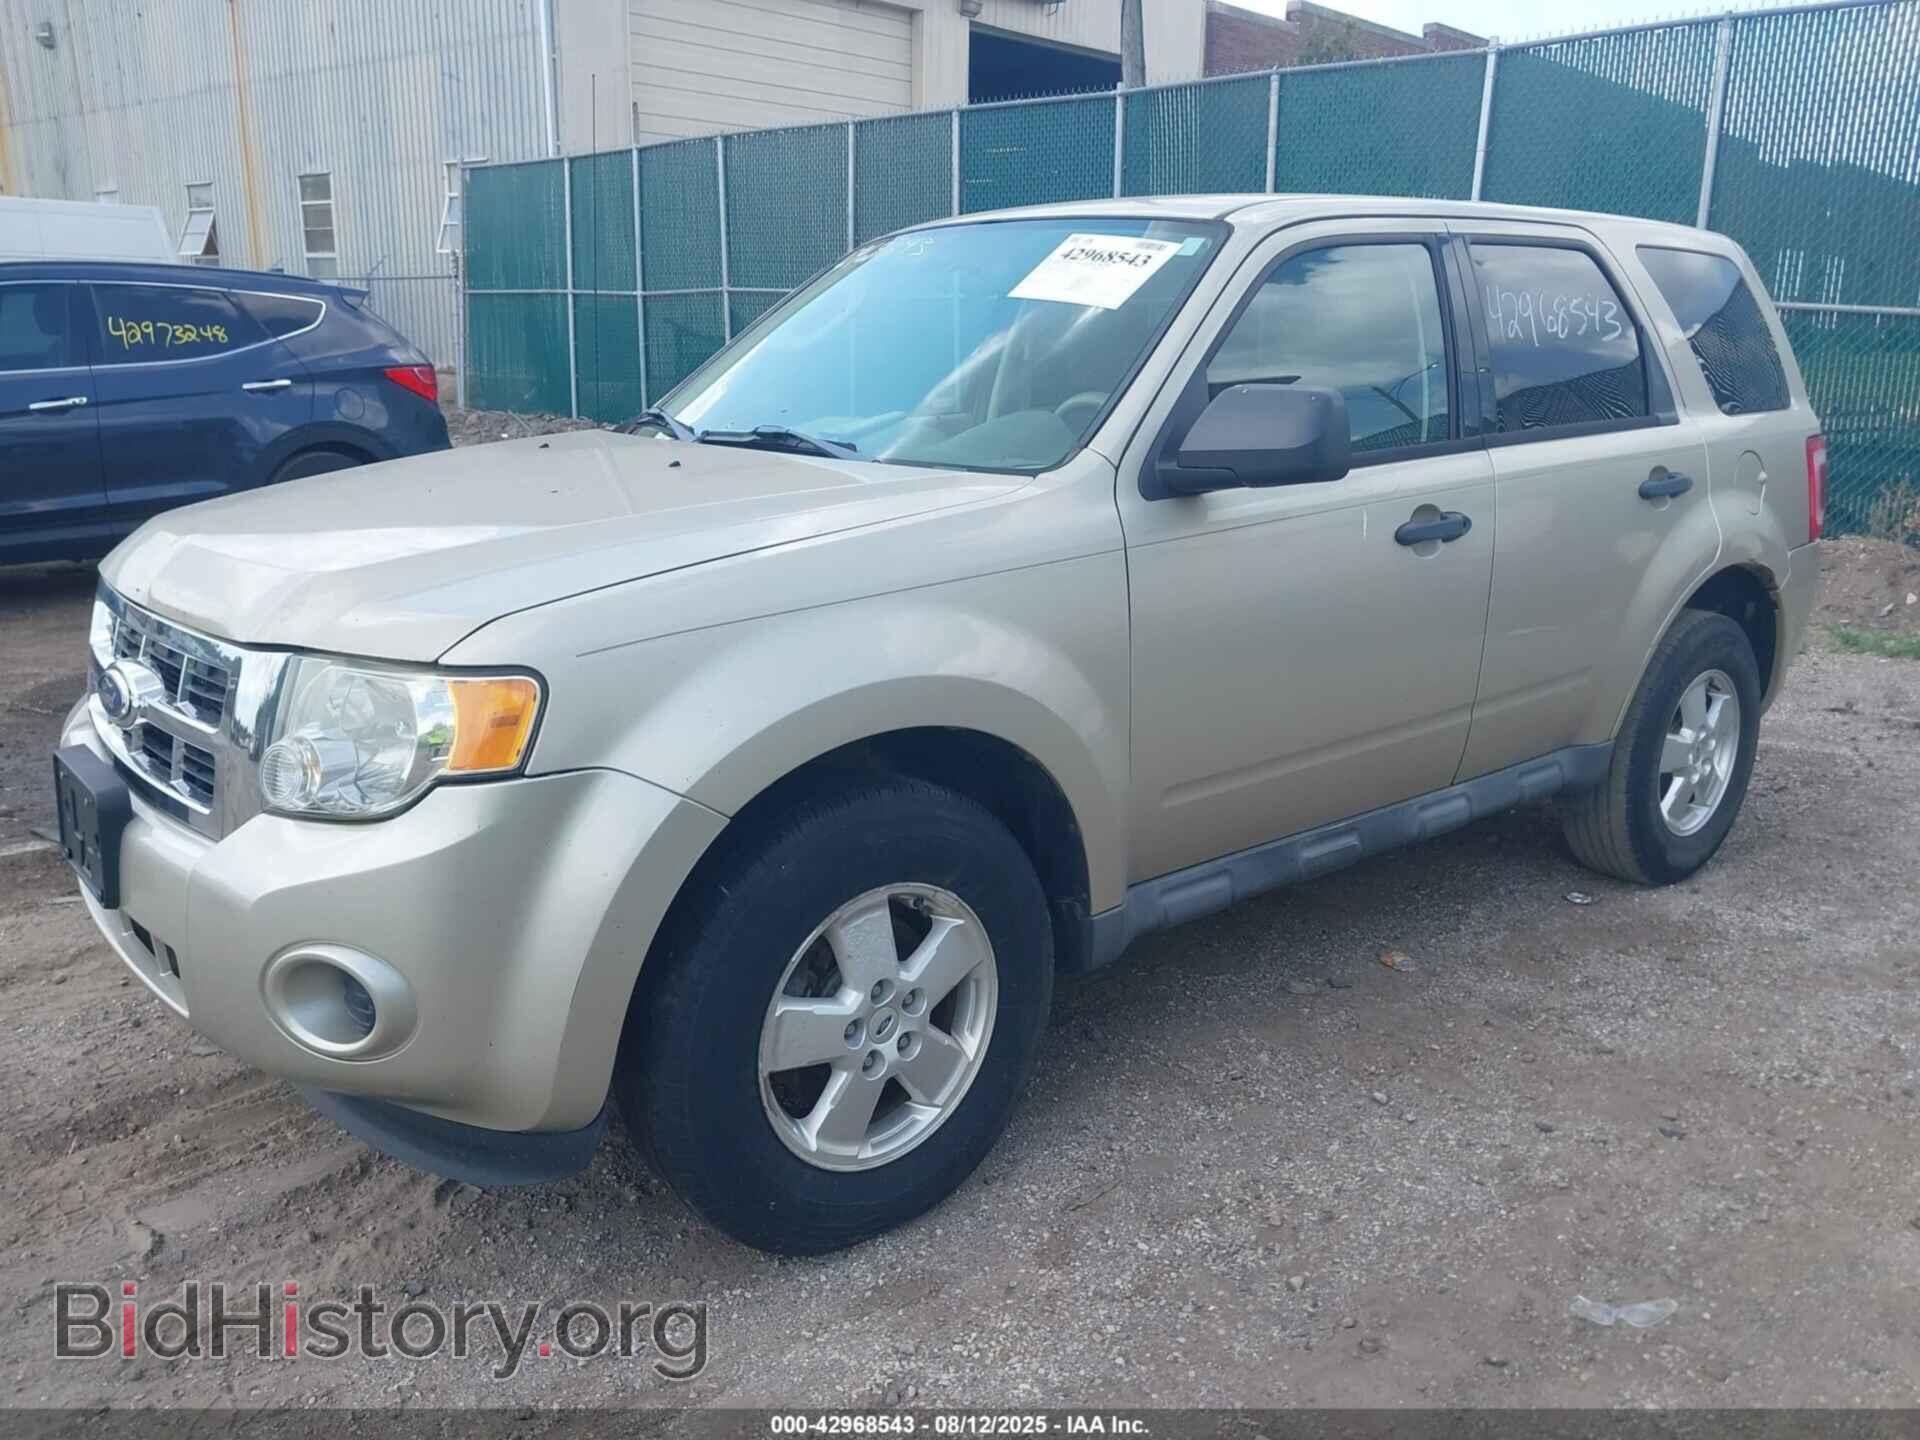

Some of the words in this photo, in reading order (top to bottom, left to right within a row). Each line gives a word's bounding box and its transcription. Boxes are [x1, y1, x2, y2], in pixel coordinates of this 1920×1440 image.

[1061, 248, 1151, 267] 42968543
[108, 316, 228, 350] 42973248
[1486, 286, 1622, 347] 42968543
